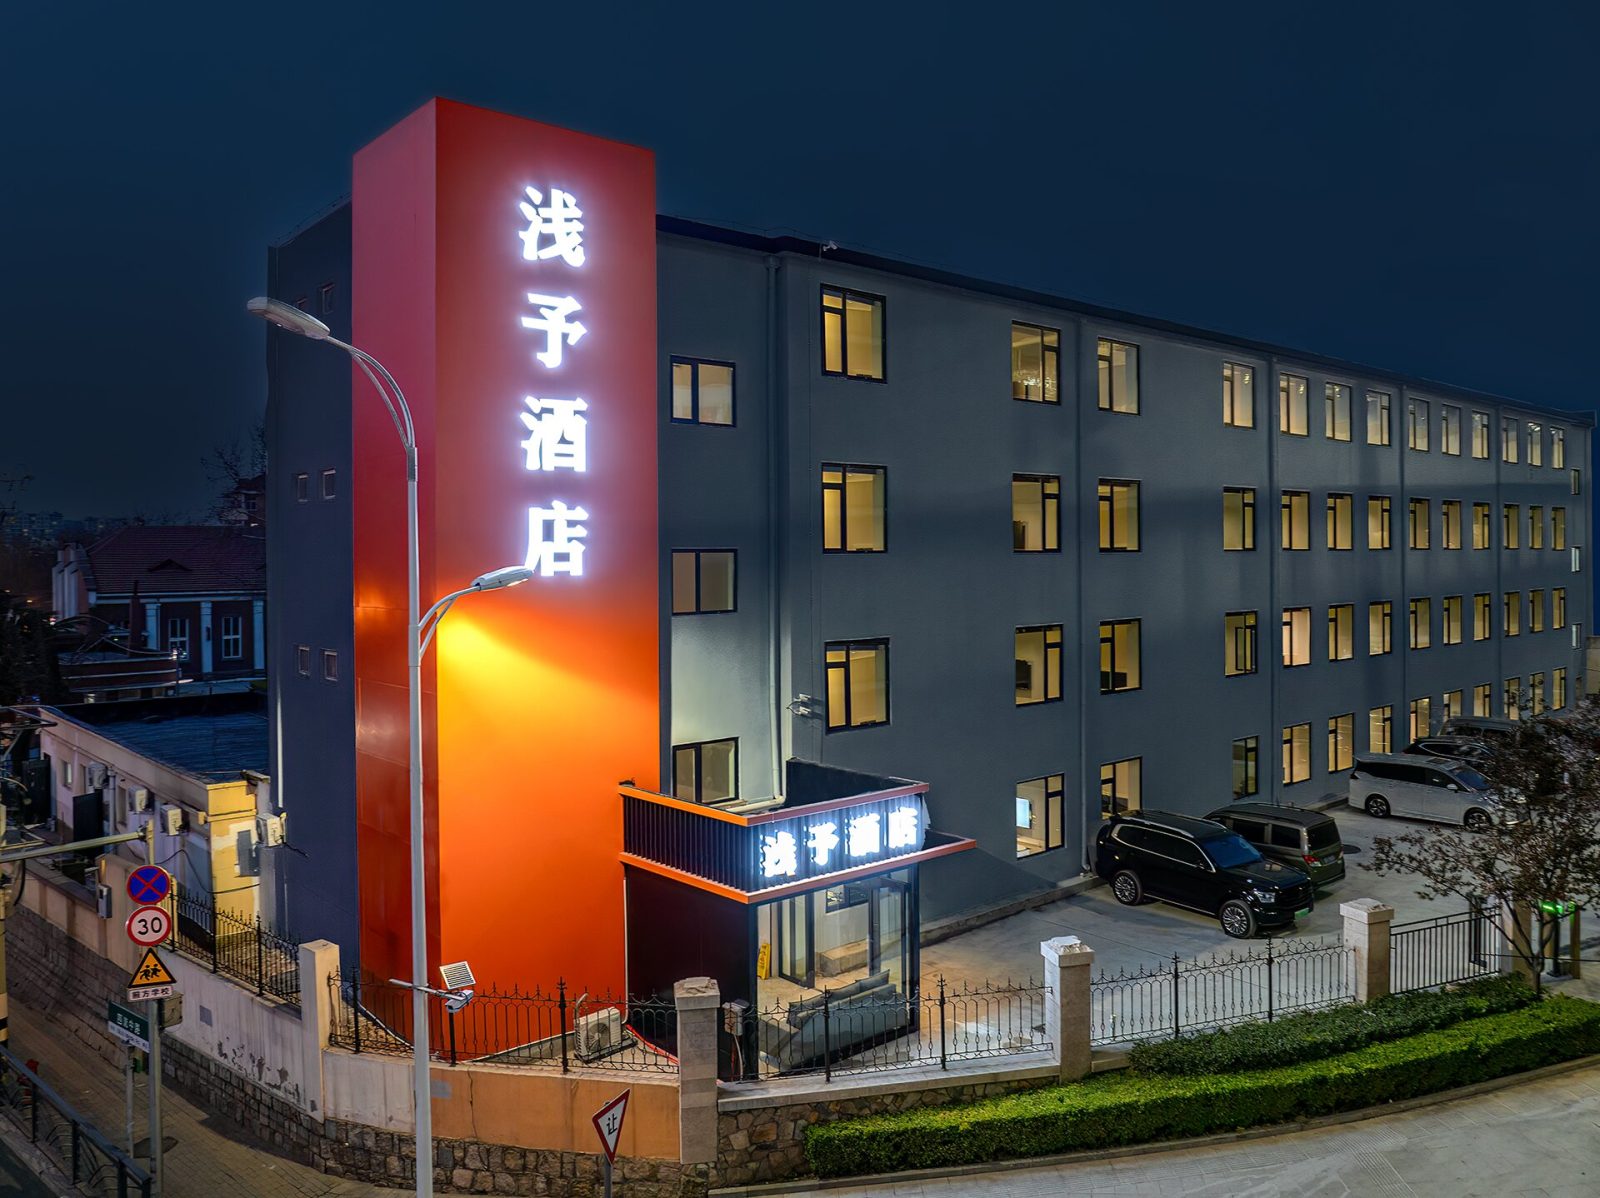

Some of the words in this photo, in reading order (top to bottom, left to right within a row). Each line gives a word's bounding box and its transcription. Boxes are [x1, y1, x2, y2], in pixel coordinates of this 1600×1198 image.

[518, 185, 589, 577] 浅予酒店
[137, 916, 163, 936] 30
[606, 1112, 618, 1135] 让
